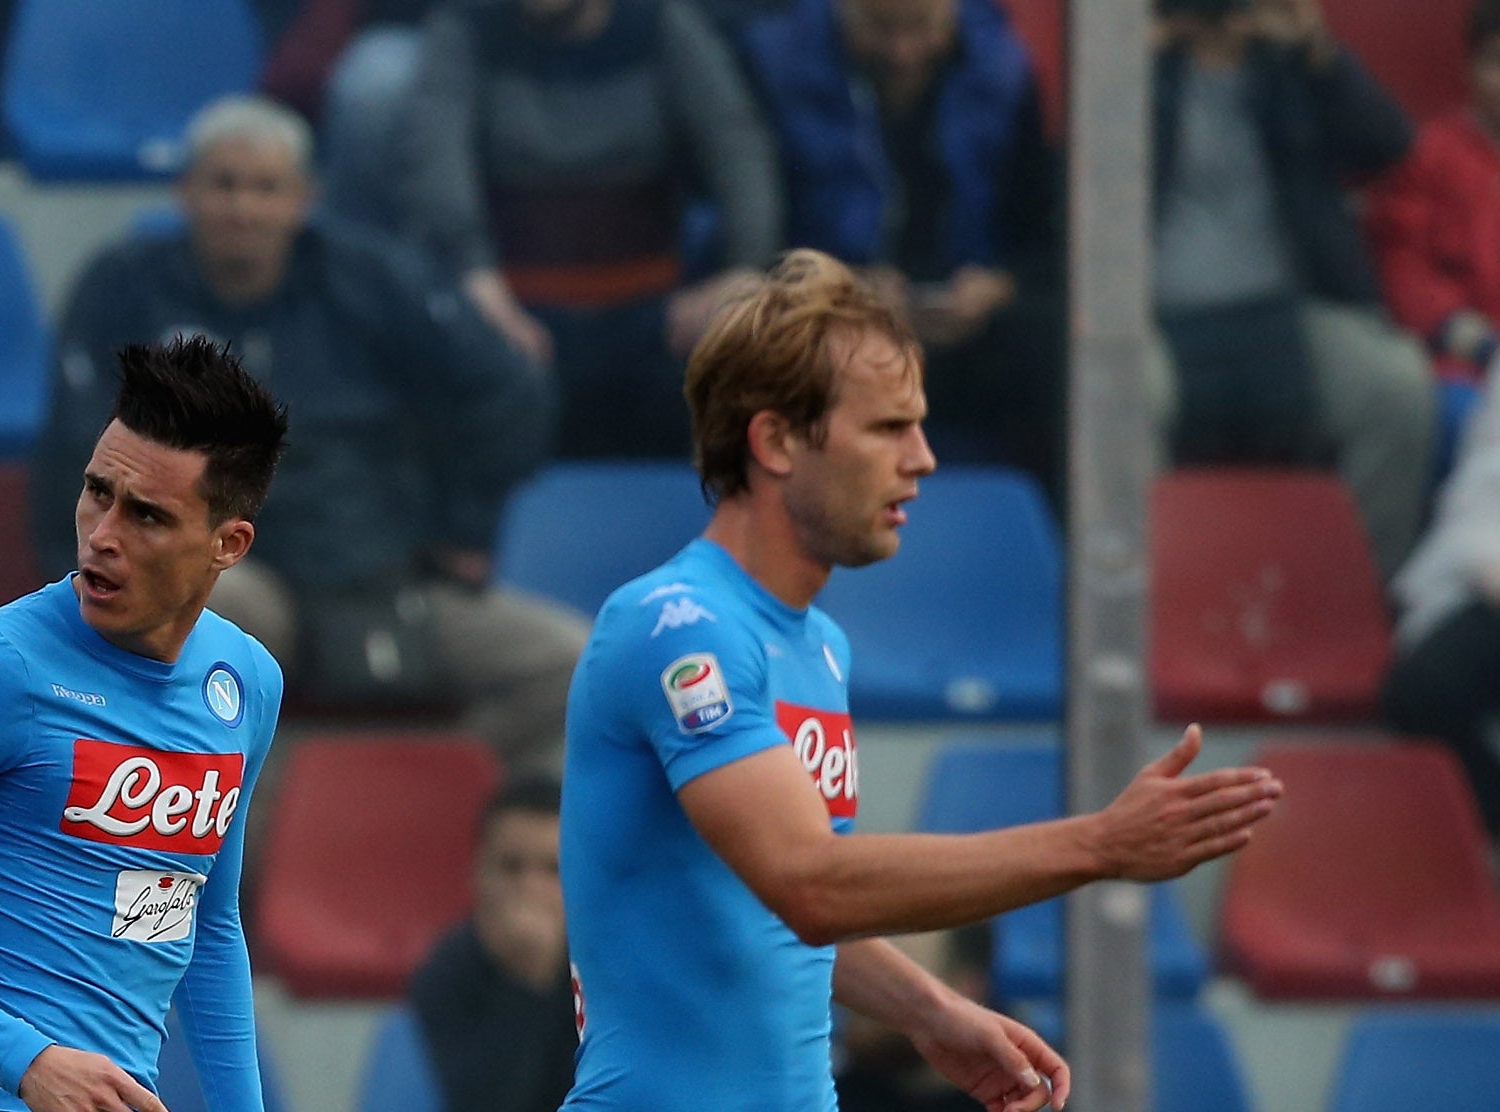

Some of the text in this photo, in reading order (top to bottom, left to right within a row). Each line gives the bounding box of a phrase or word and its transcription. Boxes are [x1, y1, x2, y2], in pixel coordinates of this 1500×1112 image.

[211, 679, 233, 710] N
[63, 756, 241, 838] Lete
[793, 716, 858, 800] Let
